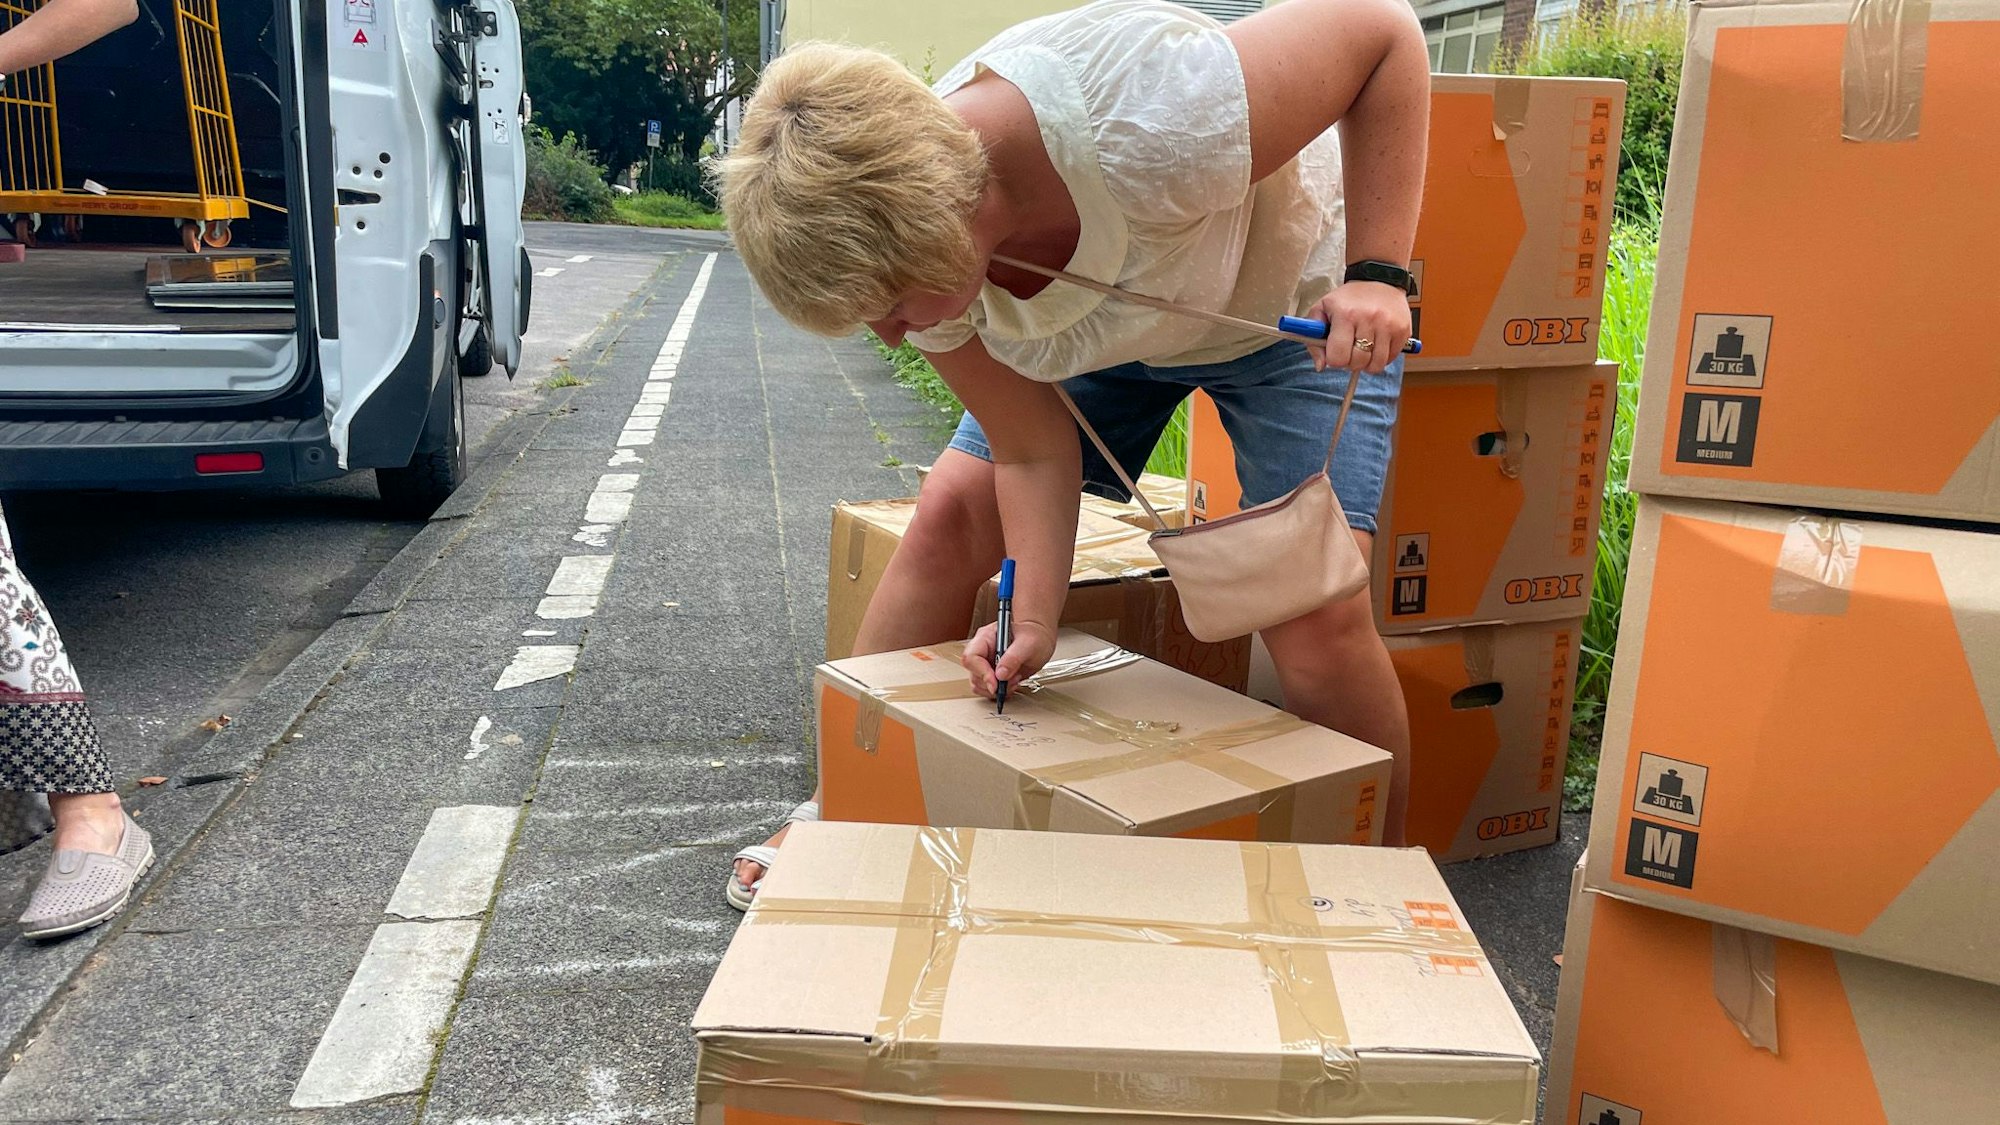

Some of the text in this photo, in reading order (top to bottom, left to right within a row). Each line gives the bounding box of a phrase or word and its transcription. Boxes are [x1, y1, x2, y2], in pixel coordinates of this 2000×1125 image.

[1503, 317, 1589, 346] OBI
[1709, 361, 1744, 374] 30 KG
[1695, 400, 1743, 444] M
[1696, 449, 1733, 460] MEDIUM
[1400, 578, 1420, 604] M
[1504, 574, 1583, 605] OBI
[1653, 795, 1683, 811] 30 KG
[1477, 807, 1550, 841] OBI
[1642, 826, 1683, 868] M
[1642, 866, 1675, 881] MEDIUM
